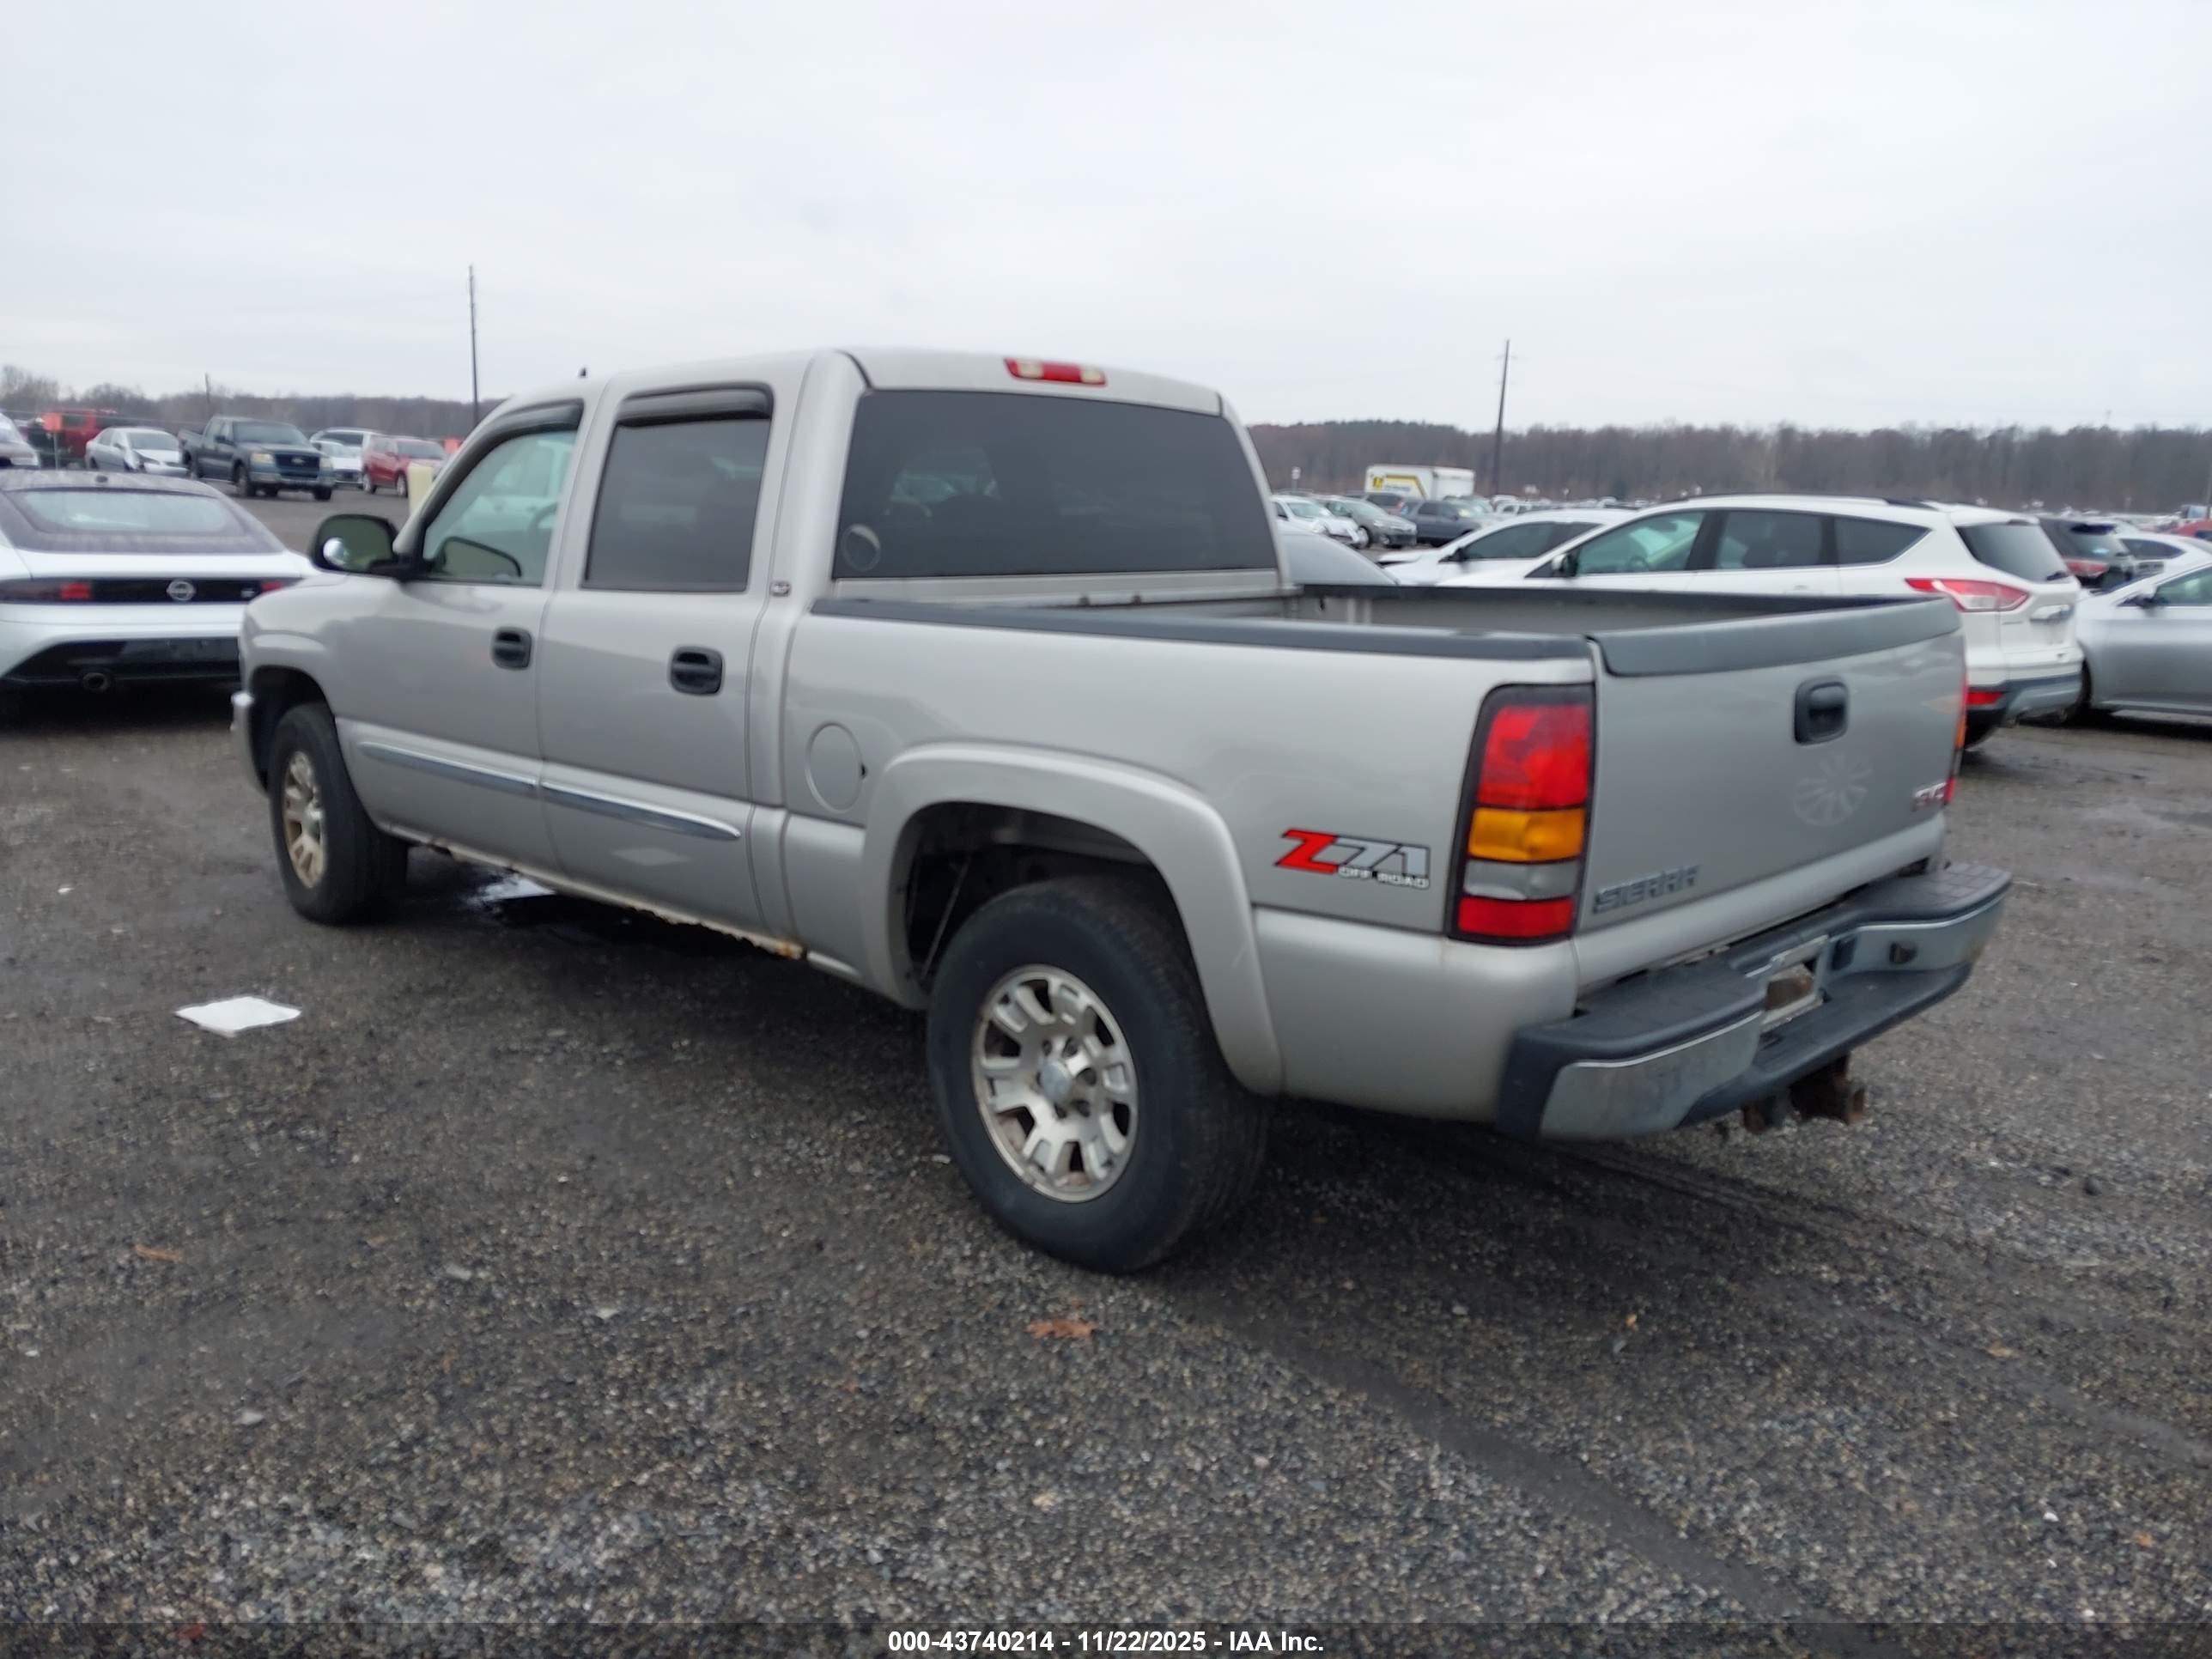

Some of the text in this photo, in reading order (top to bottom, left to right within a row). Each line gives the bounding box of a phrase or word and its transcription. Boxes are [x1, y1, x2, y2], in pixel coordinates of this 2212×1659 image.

[1275, 828, 1430, 876] Z71
[1338, 866, 1430, 890] OFF ROAD
